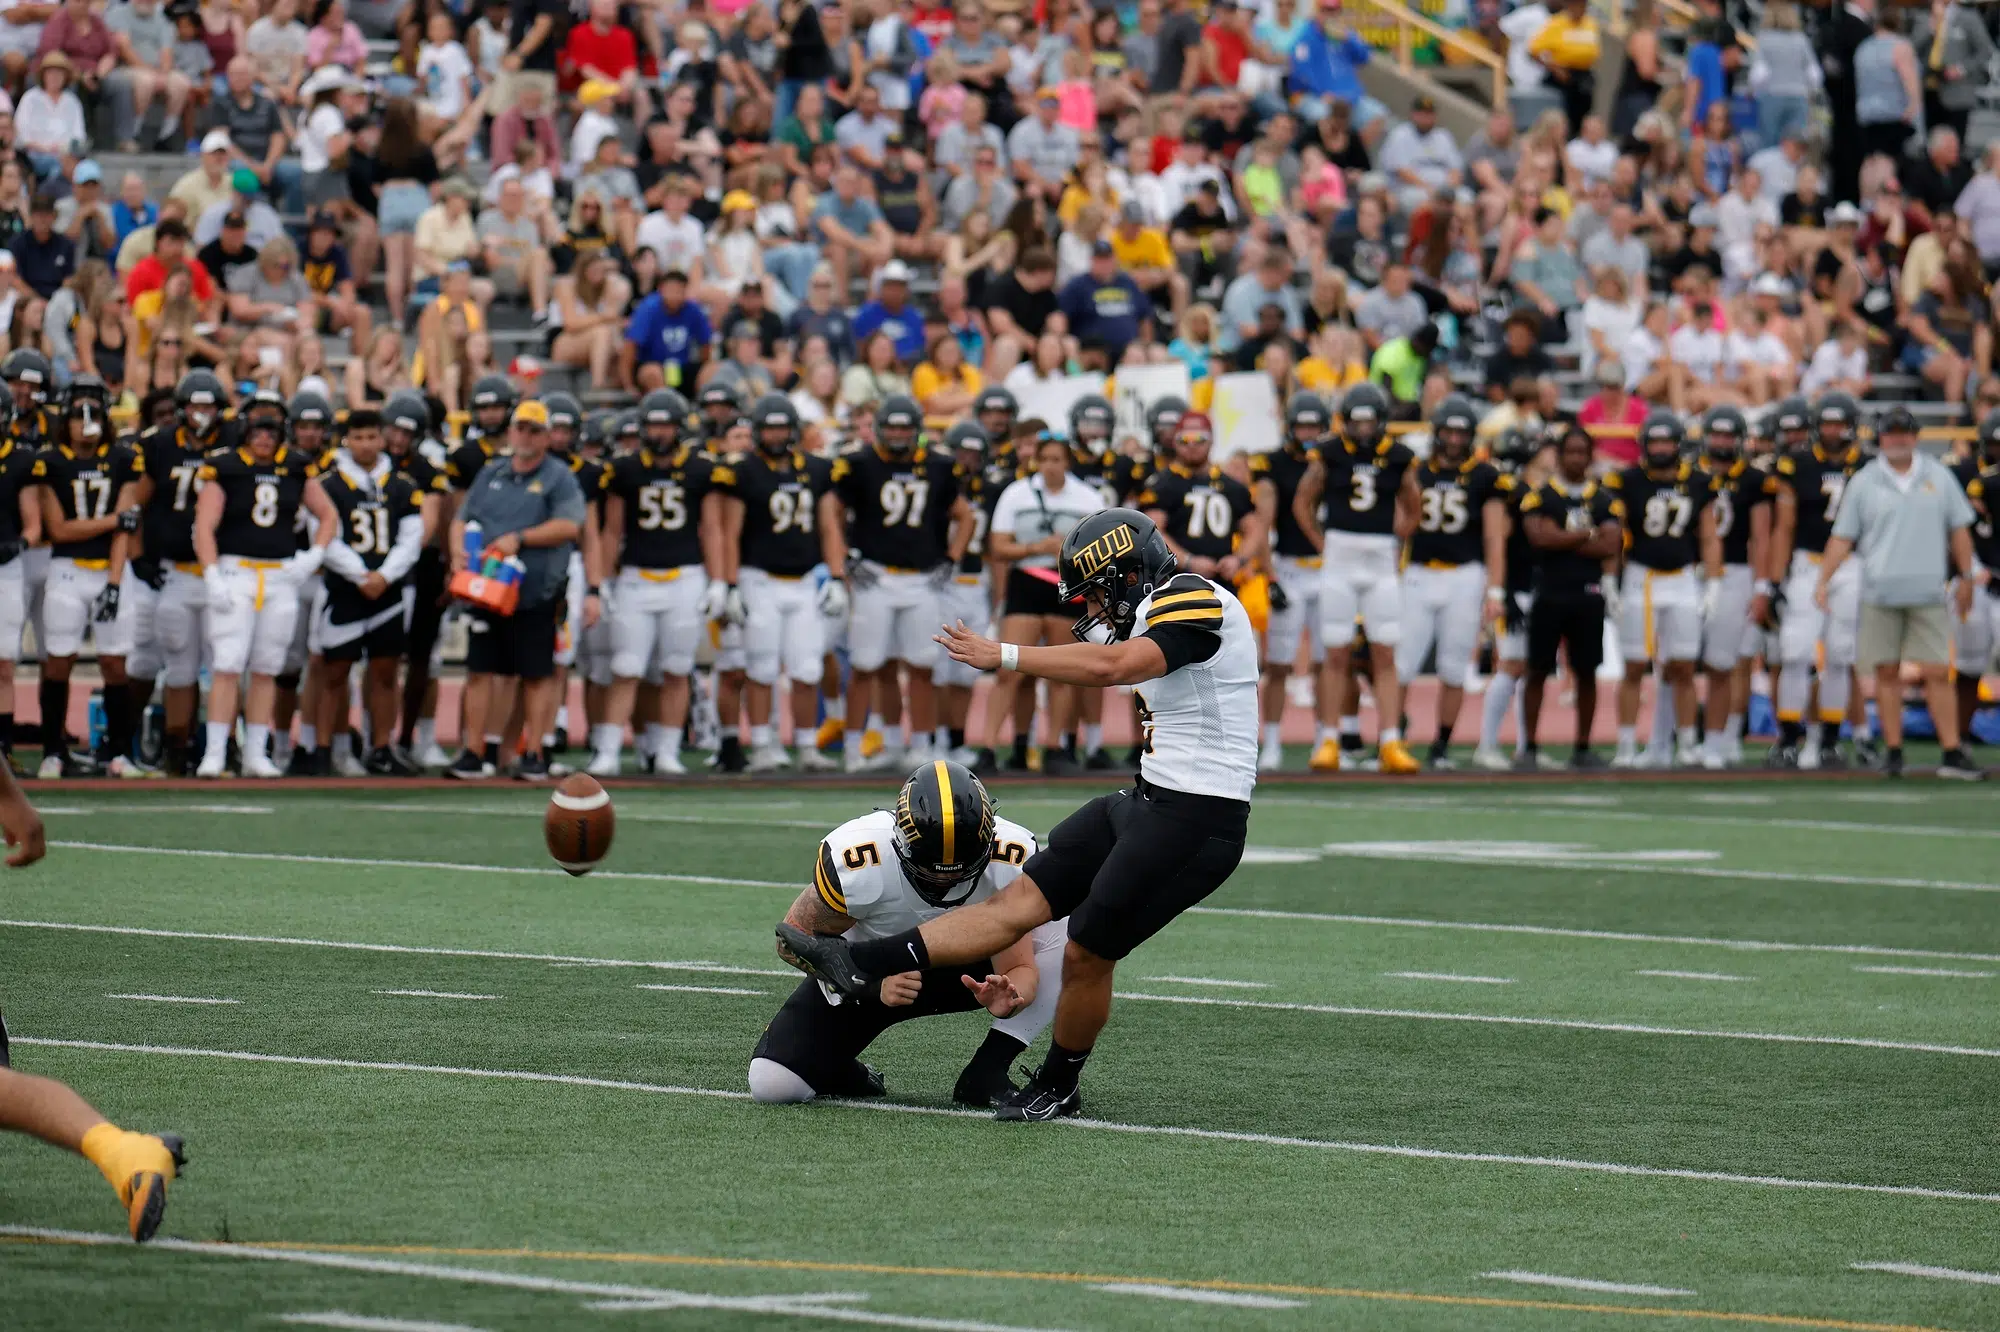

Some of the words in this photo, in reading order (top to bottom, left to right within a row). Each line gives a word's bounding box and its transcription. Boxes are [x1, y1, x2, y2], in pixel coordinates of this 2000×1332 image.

[72, 479, 111, 519] 17
[251, 483, 279, 528] 8
[638, 486, 687, 531] 55
[769, 488, 814, 533] 94
[880, 480, 930, 528] 97
[1184, 491, 1232, 538] 70
[1349, 472, 1377, 512] 3
[1419, 487, 1469, 534] 35
[350, 507, 390, 554] 31
[1643, 495, 1693, 538] 87
[1073, 523, 1134, 580] TLU
[842, 841, 882, 871] 5
[935, 863, 963, 872] Riddell
[990, 838, 1027, 867] 5
